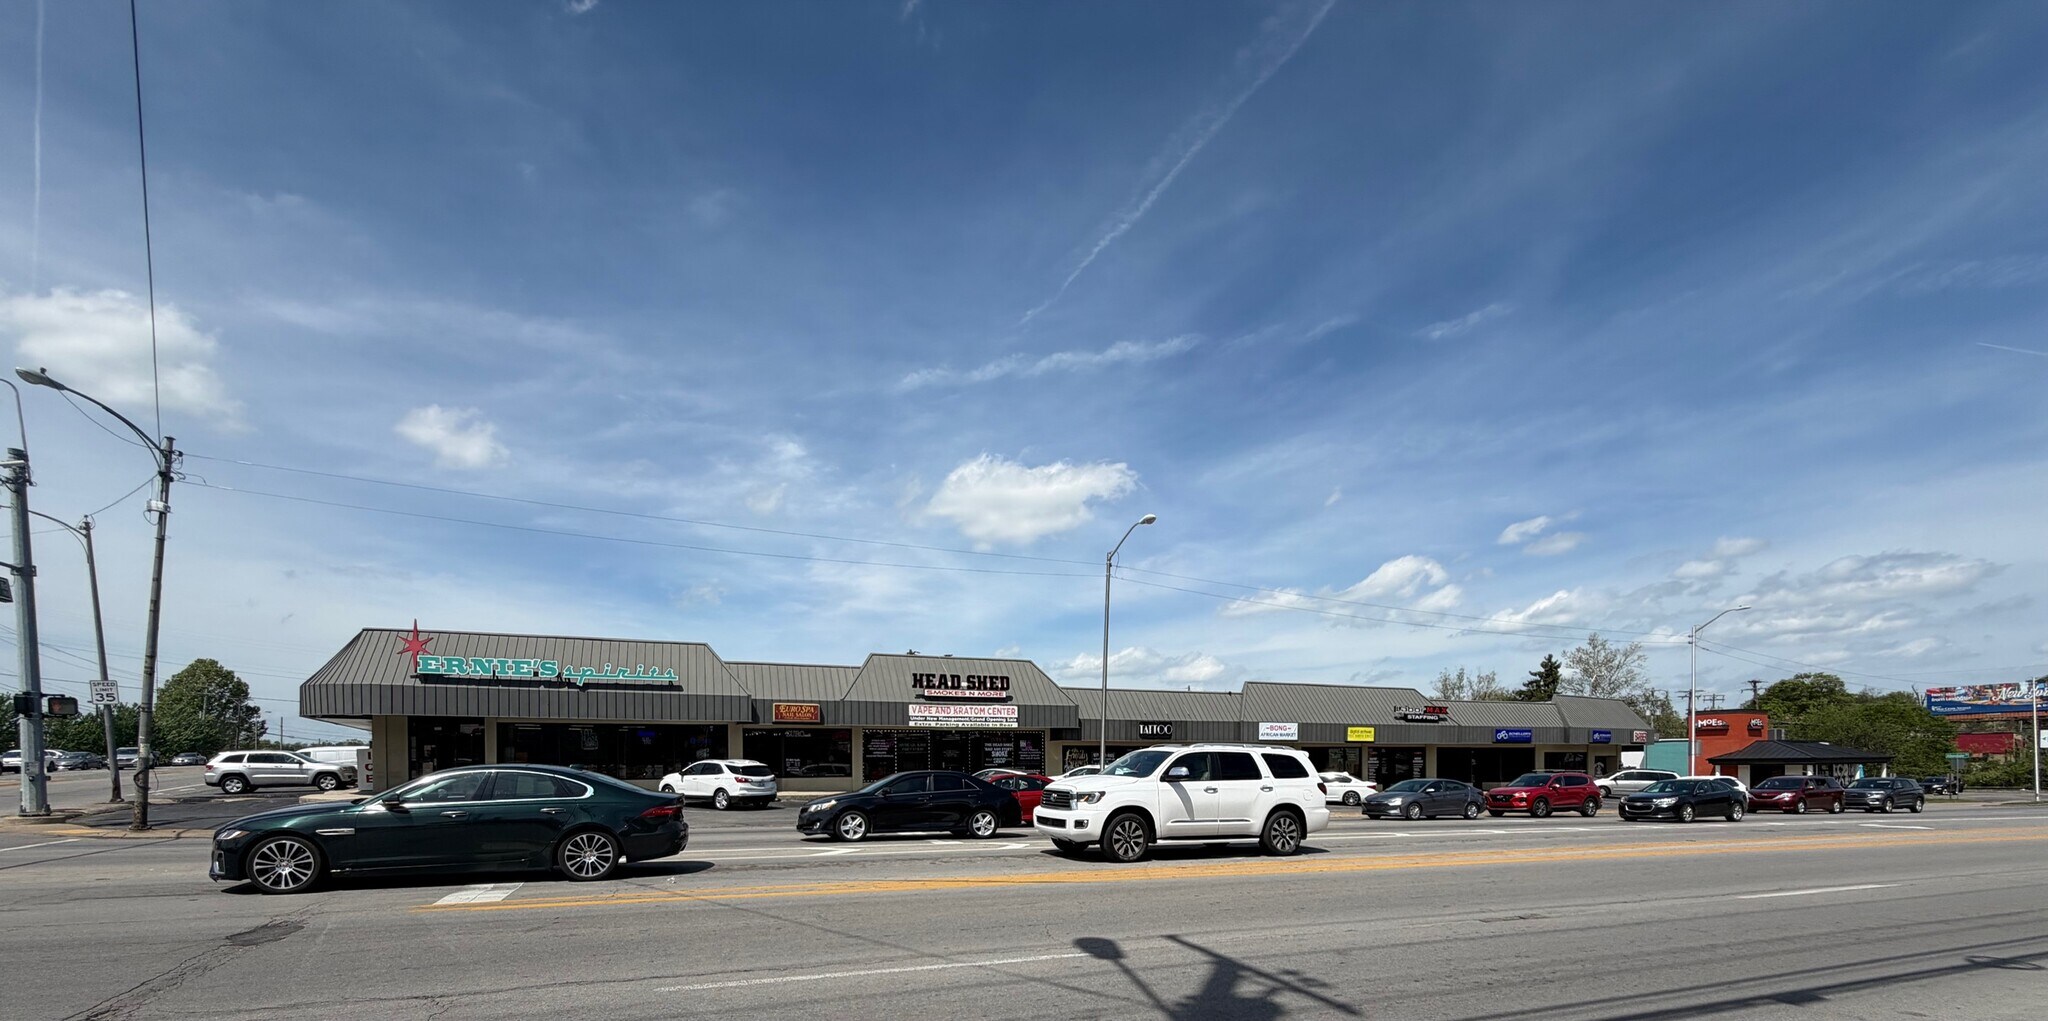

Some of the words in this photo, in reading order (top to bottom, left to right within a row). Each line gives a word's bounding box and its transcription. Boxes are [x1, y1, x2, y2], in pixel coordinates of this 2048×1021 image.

[417, 655, 558, 677] ERNIE'S
[564, 663, 678, 686] spirits
[912, 673, 961, 690] HEAD
[966, 675, 1010, 691] SHED
[96, 693, 116, 702] 35
[1992, 686, 2024, 701] New
[911, 706, 933, 714] VAPE
[935, 706, 952, 715] AND
[953, 707, 987, 716] KRATOM
[987, 707, 1016, 715] CENTER
[1139, 725, 1172, 734] TATTOO
